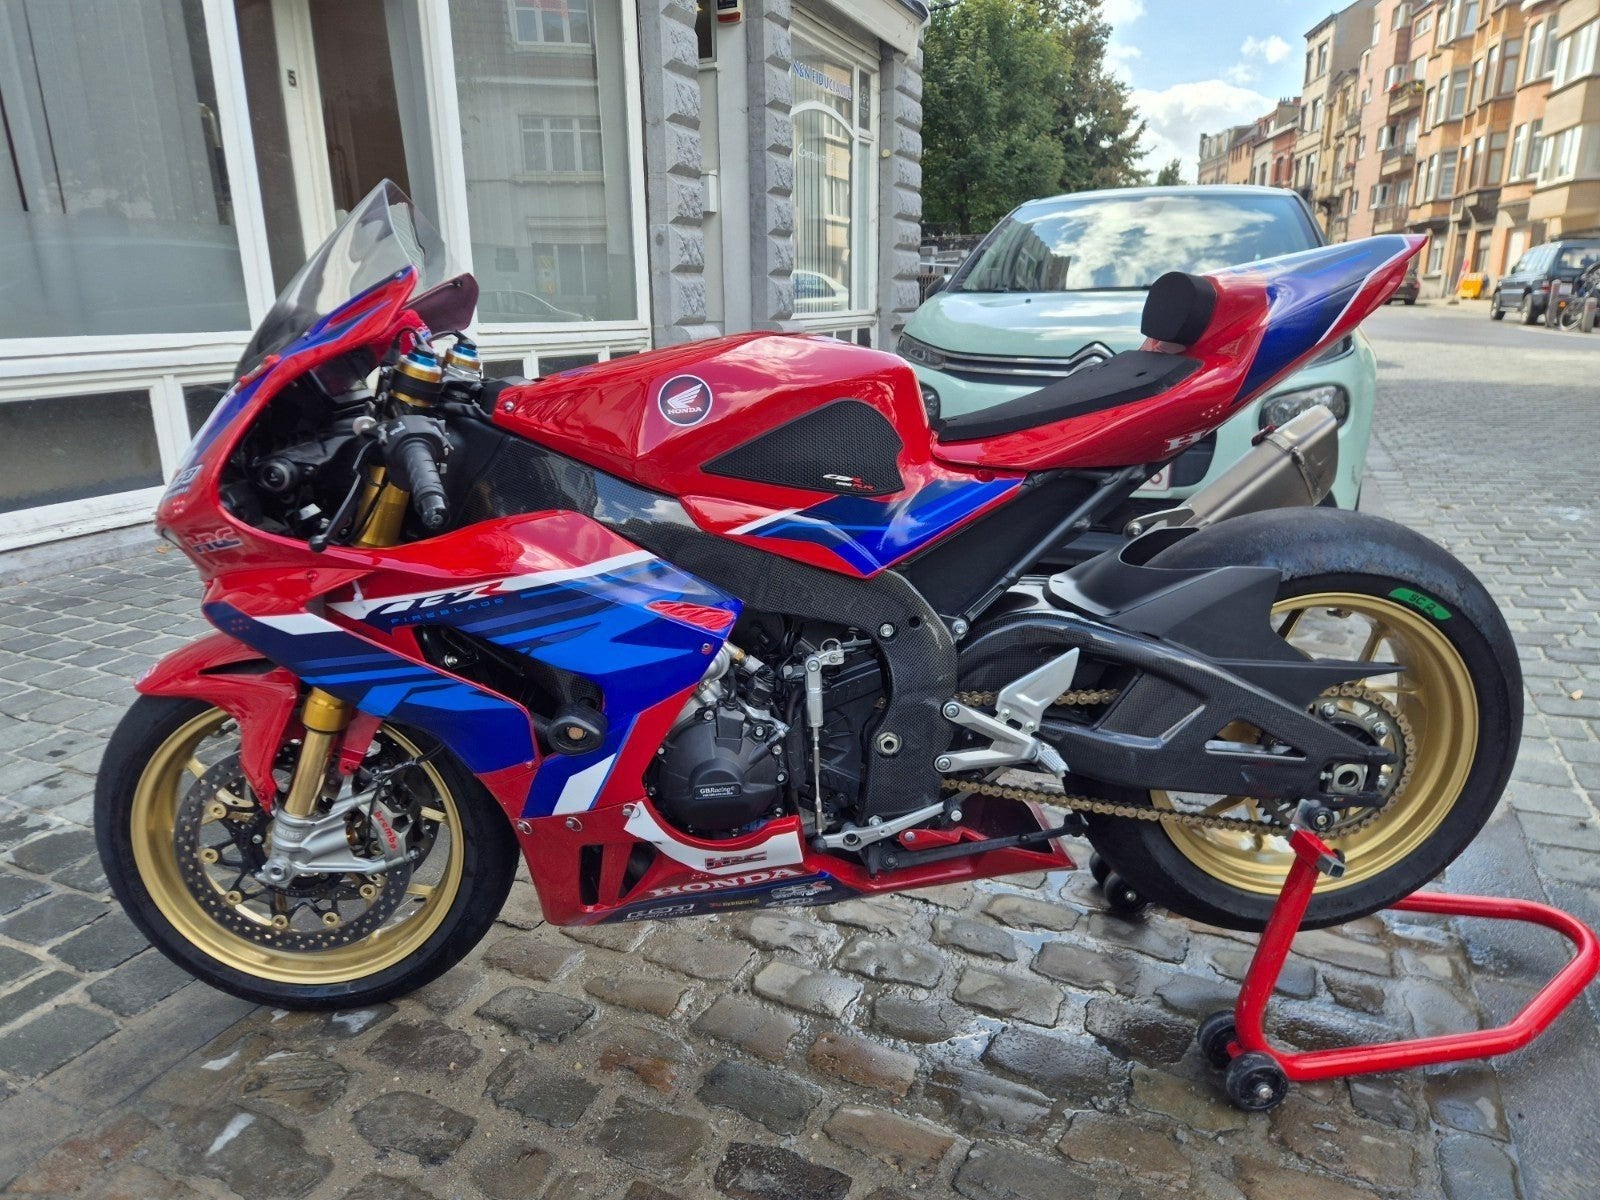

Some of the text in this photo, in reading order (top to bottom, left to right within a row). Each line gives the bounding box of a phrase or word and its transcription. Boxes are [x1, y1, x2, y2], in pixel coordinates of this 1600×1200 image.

[287, 69, 297, 87] 5
[667, 406, 702, 415] HONDA
[390, 597, 505, 624] FIREBLADE
[1409, 594, 1424, 605] SC
[374, 811, 398, 850] brembo
[649, 868, 804, 897] HONDA
